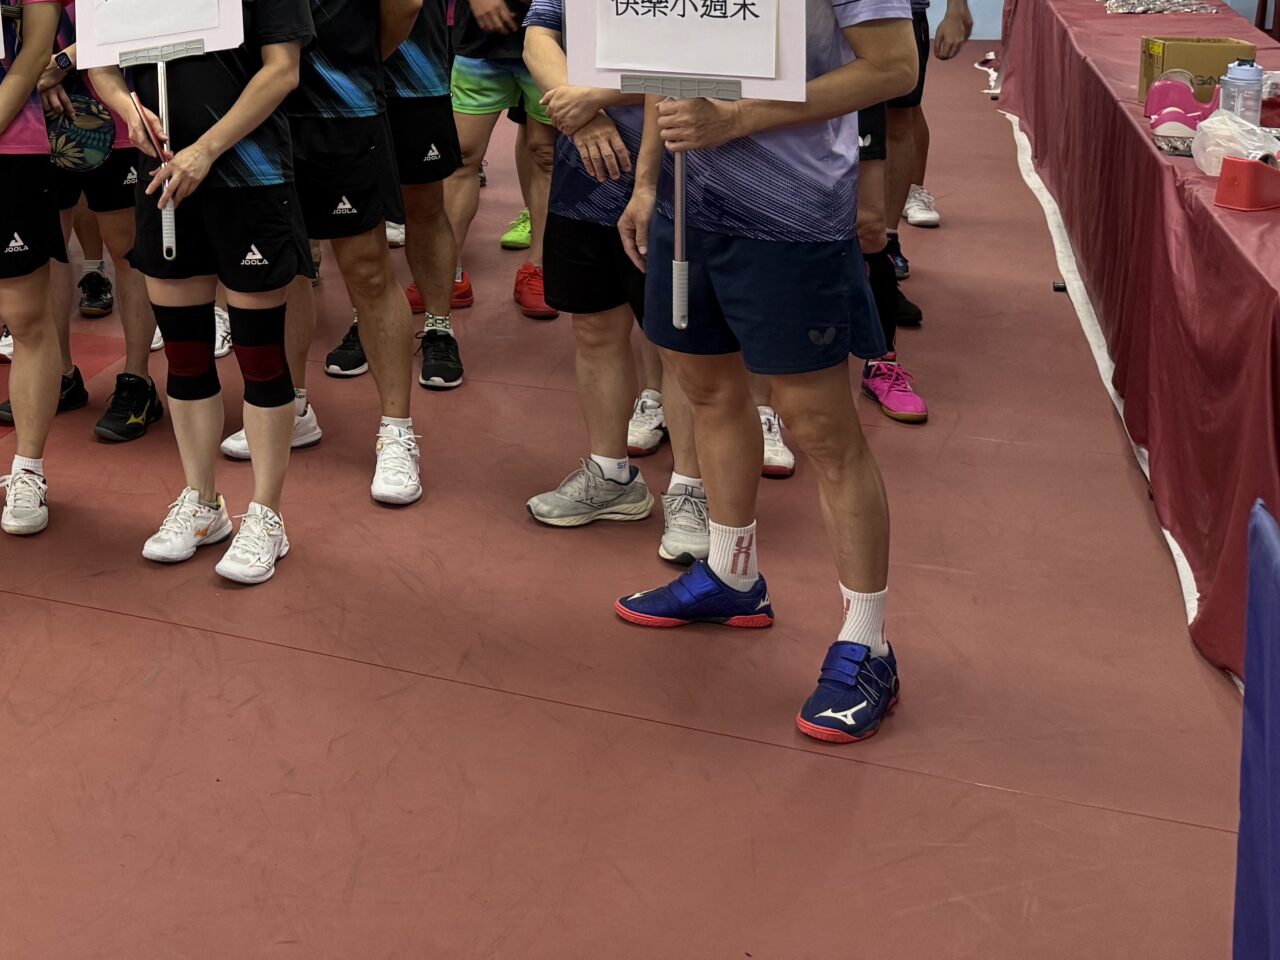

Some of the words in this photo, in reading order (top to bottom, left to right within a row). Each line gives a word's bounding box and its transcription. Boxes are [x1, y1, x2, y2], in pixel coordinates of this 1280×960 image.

[332, 207, 358, 215] JOOLA
[4, 244, 30, 253] JOOLA
[240, 258, 269, 266] JOOLA
